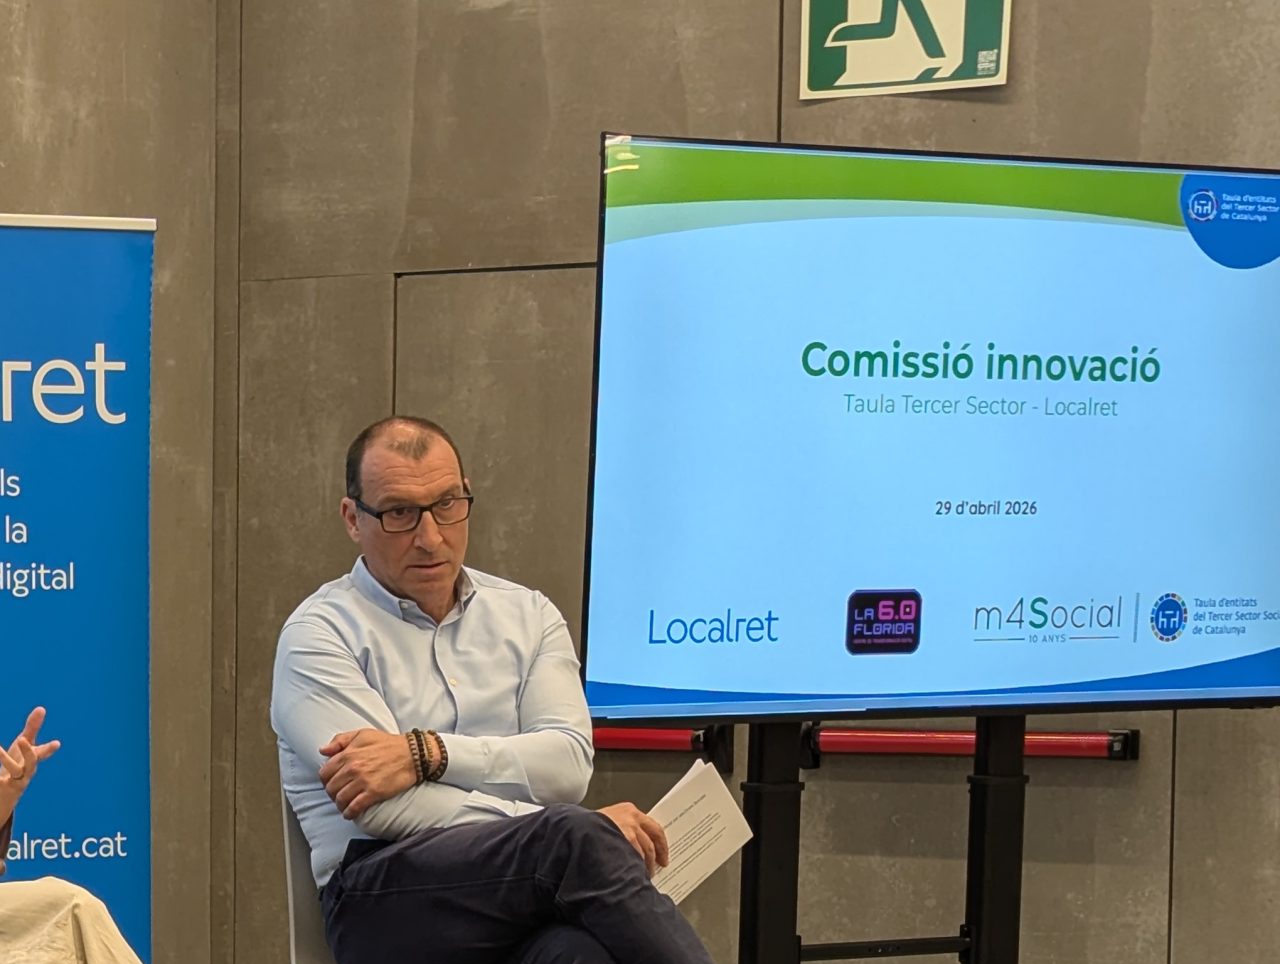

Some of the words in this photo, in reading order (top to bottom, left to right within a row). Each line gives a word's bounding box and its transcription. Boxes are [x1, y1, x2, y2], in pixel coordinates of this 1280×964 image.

[801, 340, 975, 380] Comissió
[986, 342, 1161, 383] innovació
[843, 393, 895, 414] Taula
[901, 395, 961, 415] Tercer
[965, 395, 1027, 416] Sector
[1044, 397, 1119, 417] Localret
[935, 501, 952, 516] 29
[1004, 501, 1038, 516] 2026
[5, 515, 27, 543] la
[854, 608, 874, 621] LA
[878, 600, 916, 620] 6.0
[1194, 598, 1217, 608] Taula
[974, 596, 1122, 630] m4Social
[1193, 611, 1206, 621] del
[1208, 611, 1233, 621] Tercer
[1235, 610, 1261, 620] Sector
[649, 608, 779, 644] Localret
[853, 623, 914, 635] FLORIDA
[1192, 625, 1203, 635] de
[1204, 625, 1246, 635] Catalunya
[1028, 634, 1038, 643] 10
[1042, 633, 1066, 643] ANYS
